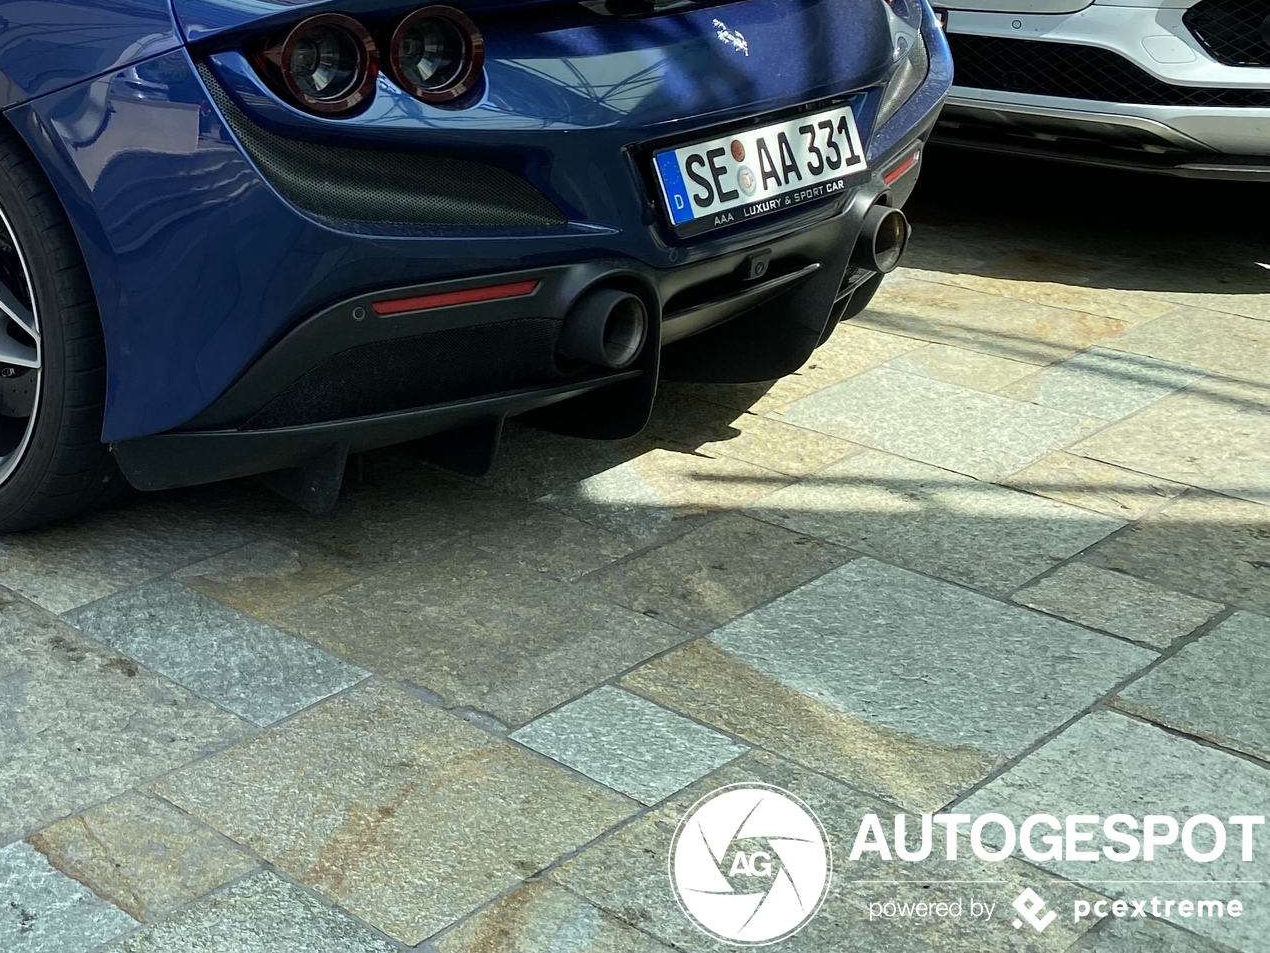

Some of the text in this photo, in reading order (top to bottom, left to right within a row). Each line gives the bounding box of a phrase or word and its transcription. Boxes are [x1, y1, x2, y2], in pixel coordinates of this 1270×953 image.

[685, 115, 861, 208] SE AA 331
[673, 194, 684, 210] D
[714, 179, 845, 226] AAA LUXURY & SPORT CAR
